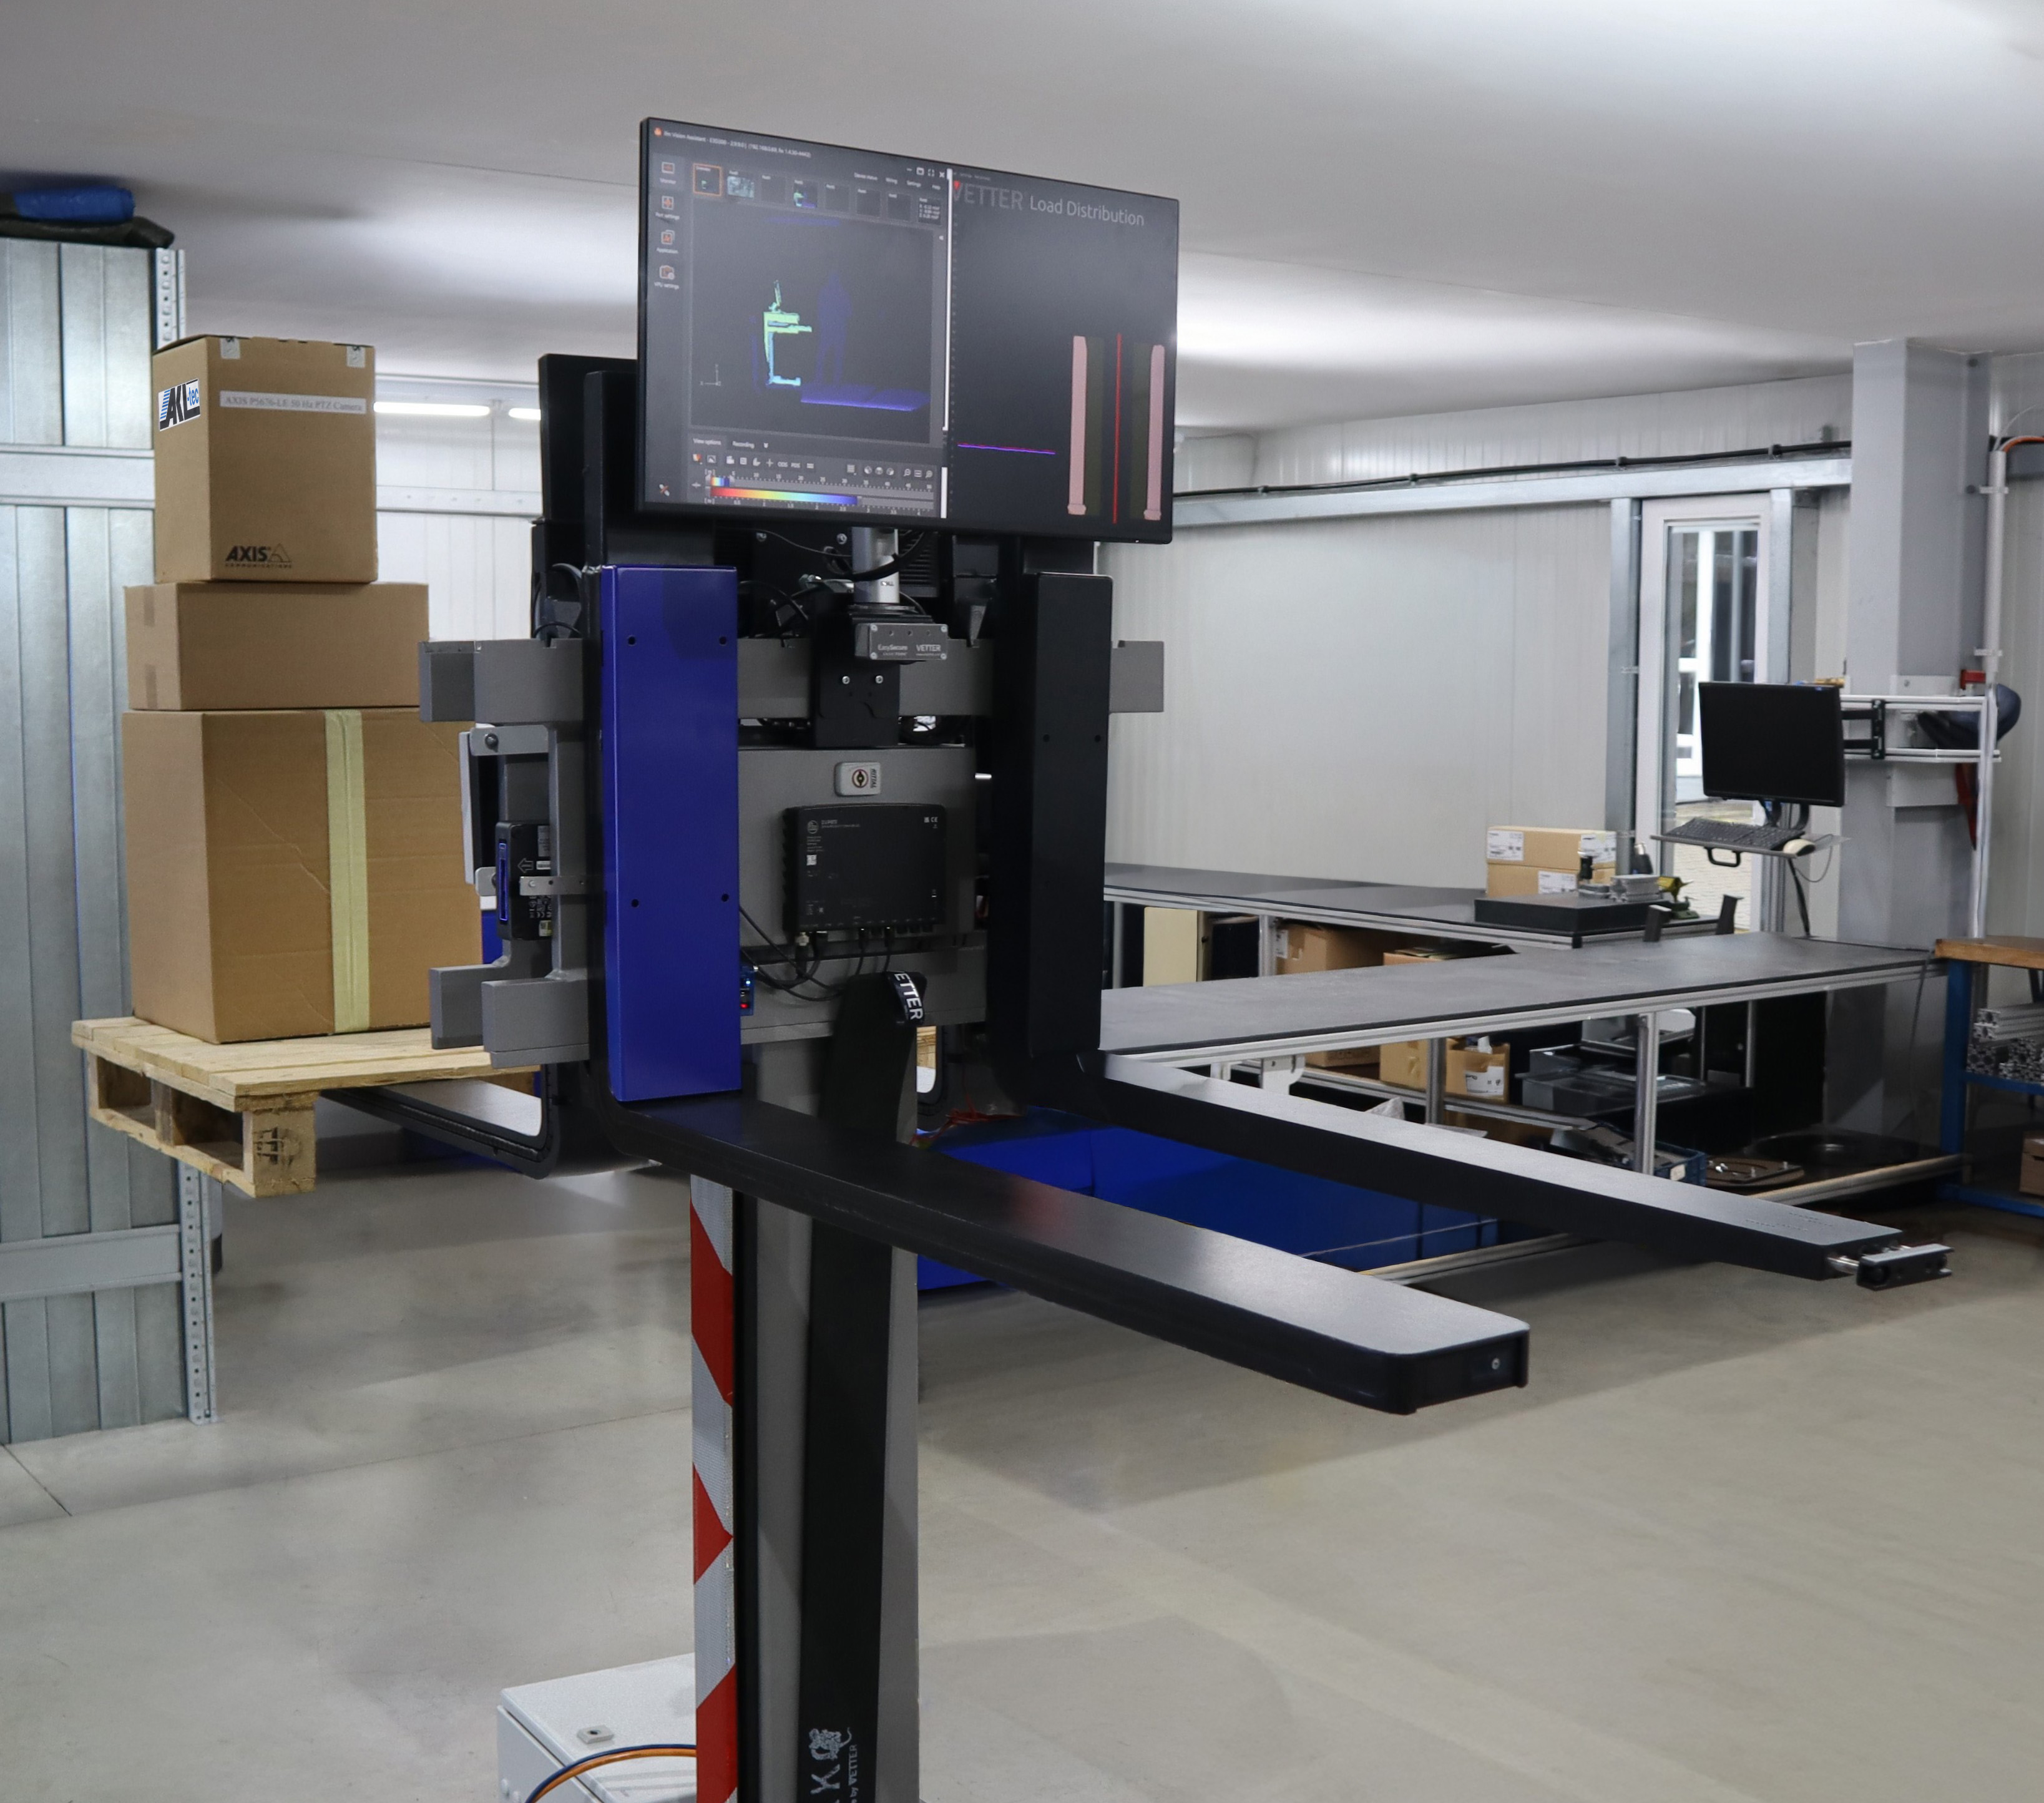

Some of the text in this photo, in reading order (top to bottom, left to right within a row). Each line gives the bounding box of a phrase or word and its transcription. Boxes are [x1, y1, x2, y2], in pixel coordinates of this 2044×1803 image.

[952, 180, 1145, 227] VETTER Load Distribution
[225, 545, 268, 562] AXIS
[916, 644, 942, 652] VETTER
[894, 972, 924, 1020] ETTER
[848, 1744, 858, 1786] VETTER
